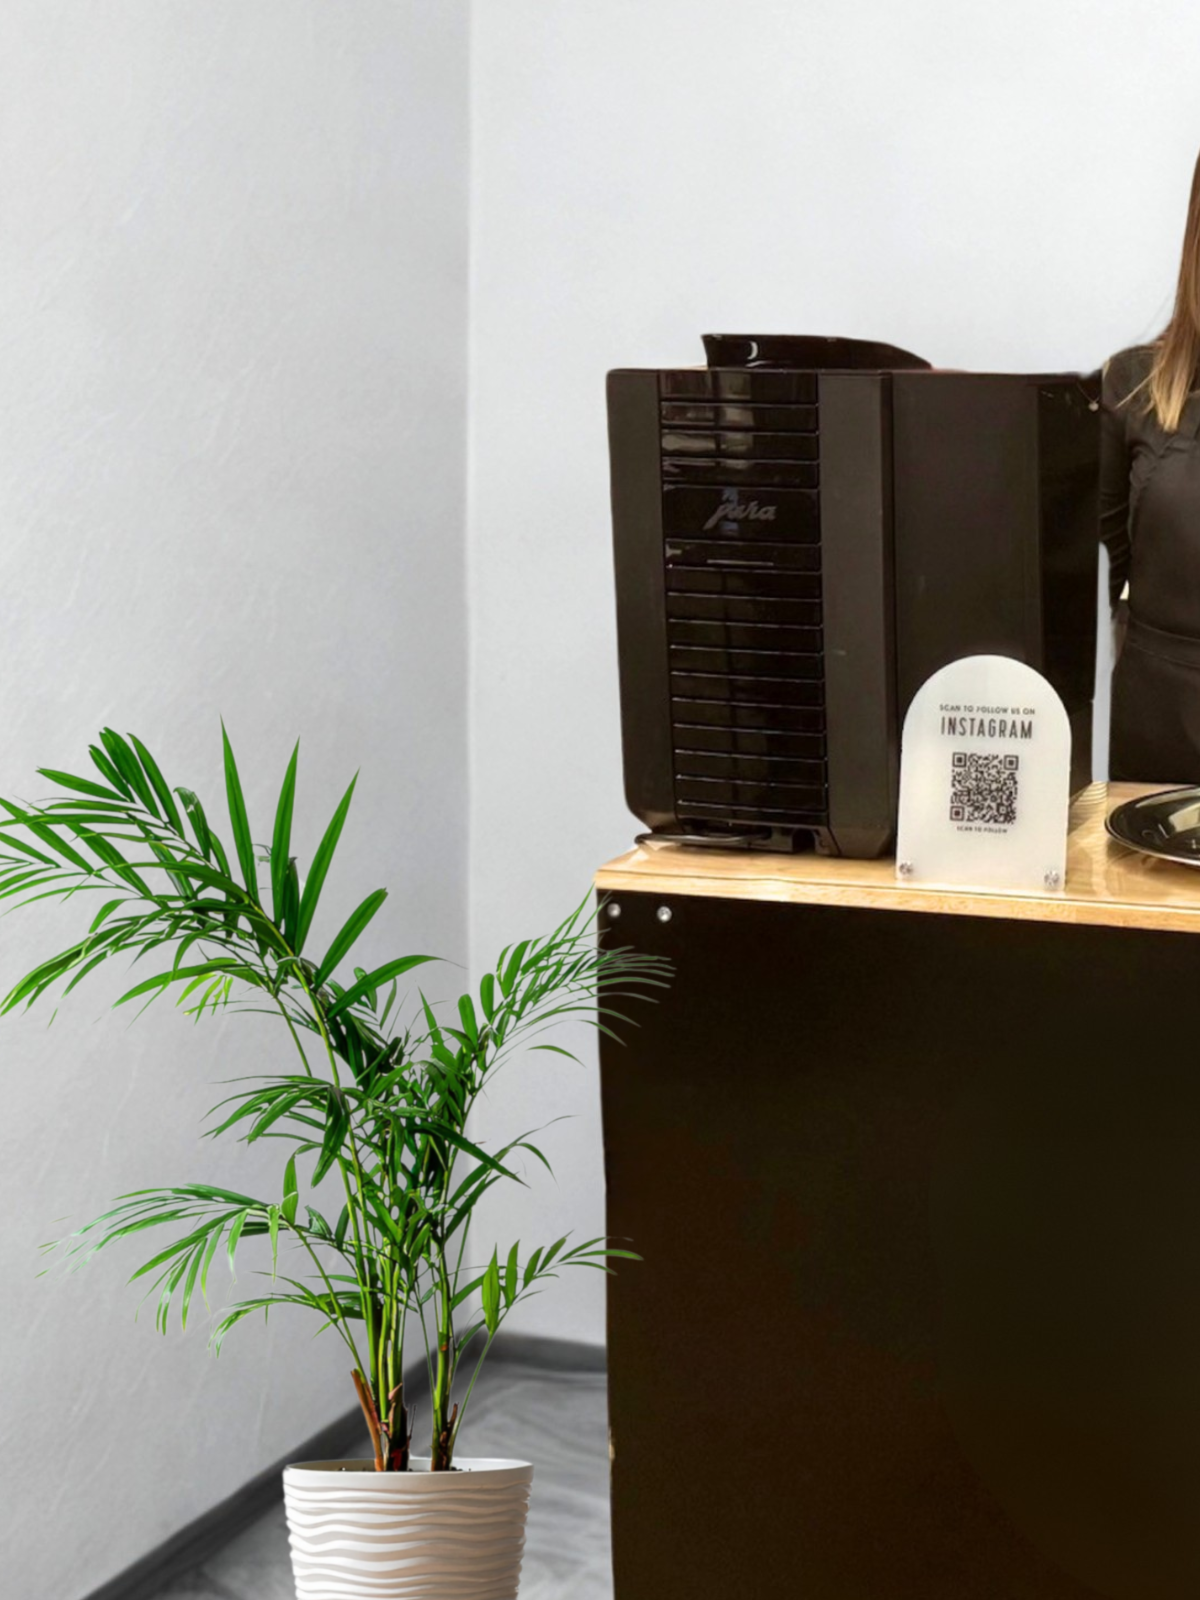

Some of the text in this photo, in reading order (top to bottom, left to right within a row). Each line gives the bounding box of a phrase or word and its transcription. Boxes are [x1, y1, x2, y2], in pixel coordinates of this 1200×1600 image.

[703, 494, 777, 530] jura
[939, 703, 1036, 715] SCAN TO FOLLOW US ON
[940, 716, 1033, 739] INSTAGRAM
